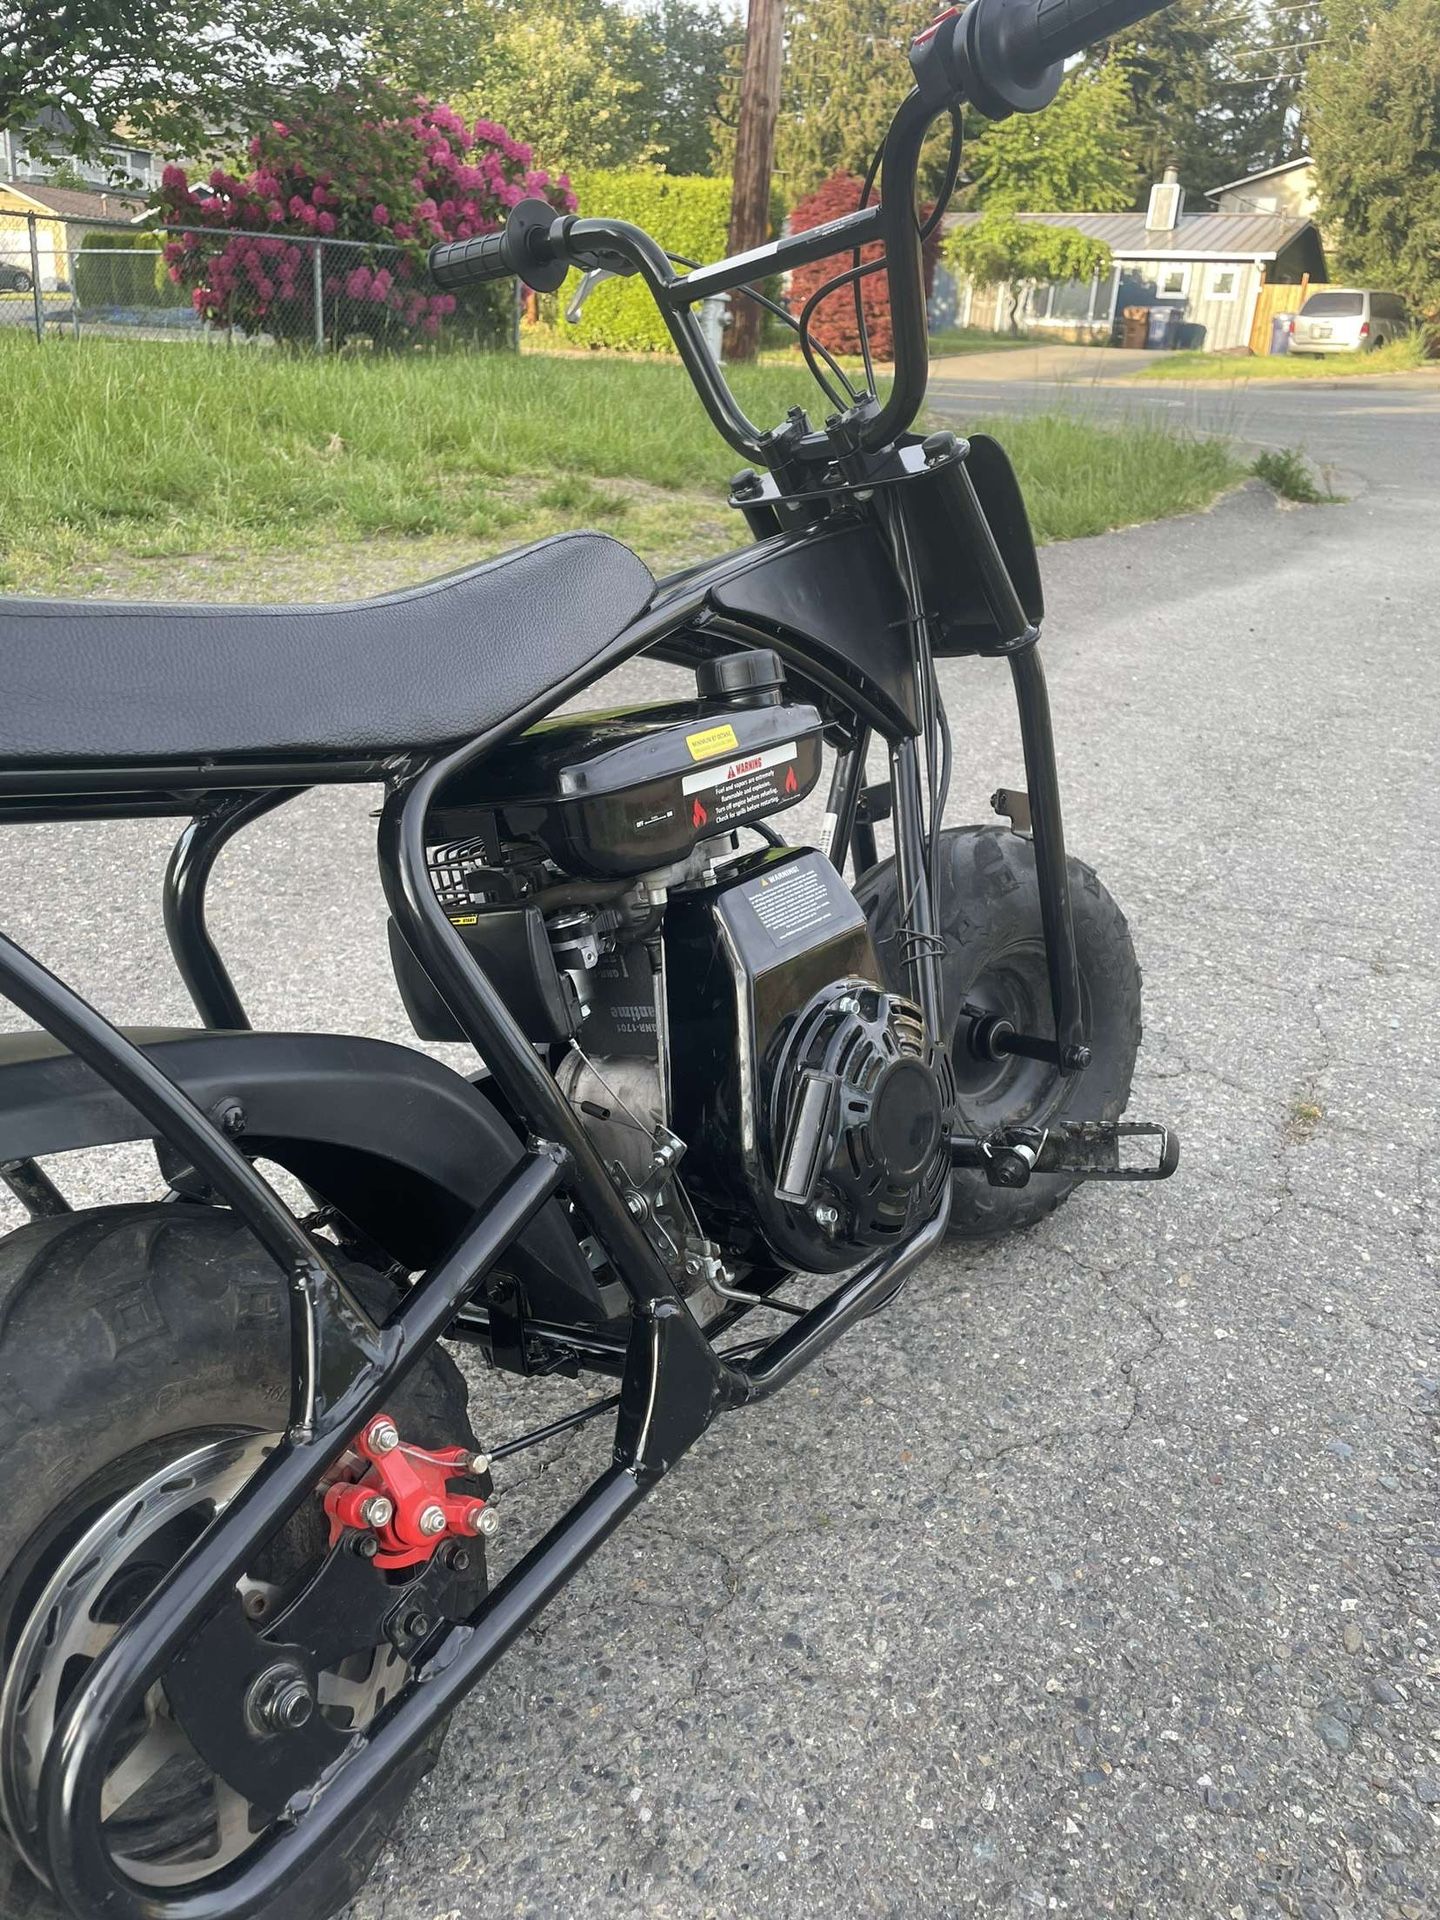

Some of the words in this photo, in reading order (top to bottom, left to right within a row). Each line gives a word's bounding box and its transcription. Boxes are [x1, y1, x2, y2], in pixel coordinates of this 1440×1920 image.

[736, 757, 762, 774] WARNING
[755, 770, 775, 781] extremely
[721, 790, 743, 802] flammable
[744, 786, 752, 795] and
[716, 806, 726, 814] Turn
[733, 800, 747, 810] engine
[747, 795, 760, 803] before
[716, 814, 729, 823] Check
[736, 808, 746, 817] spills
[747, 803, 760, 812] before
[768, 866, 800, 884] WARNING!
